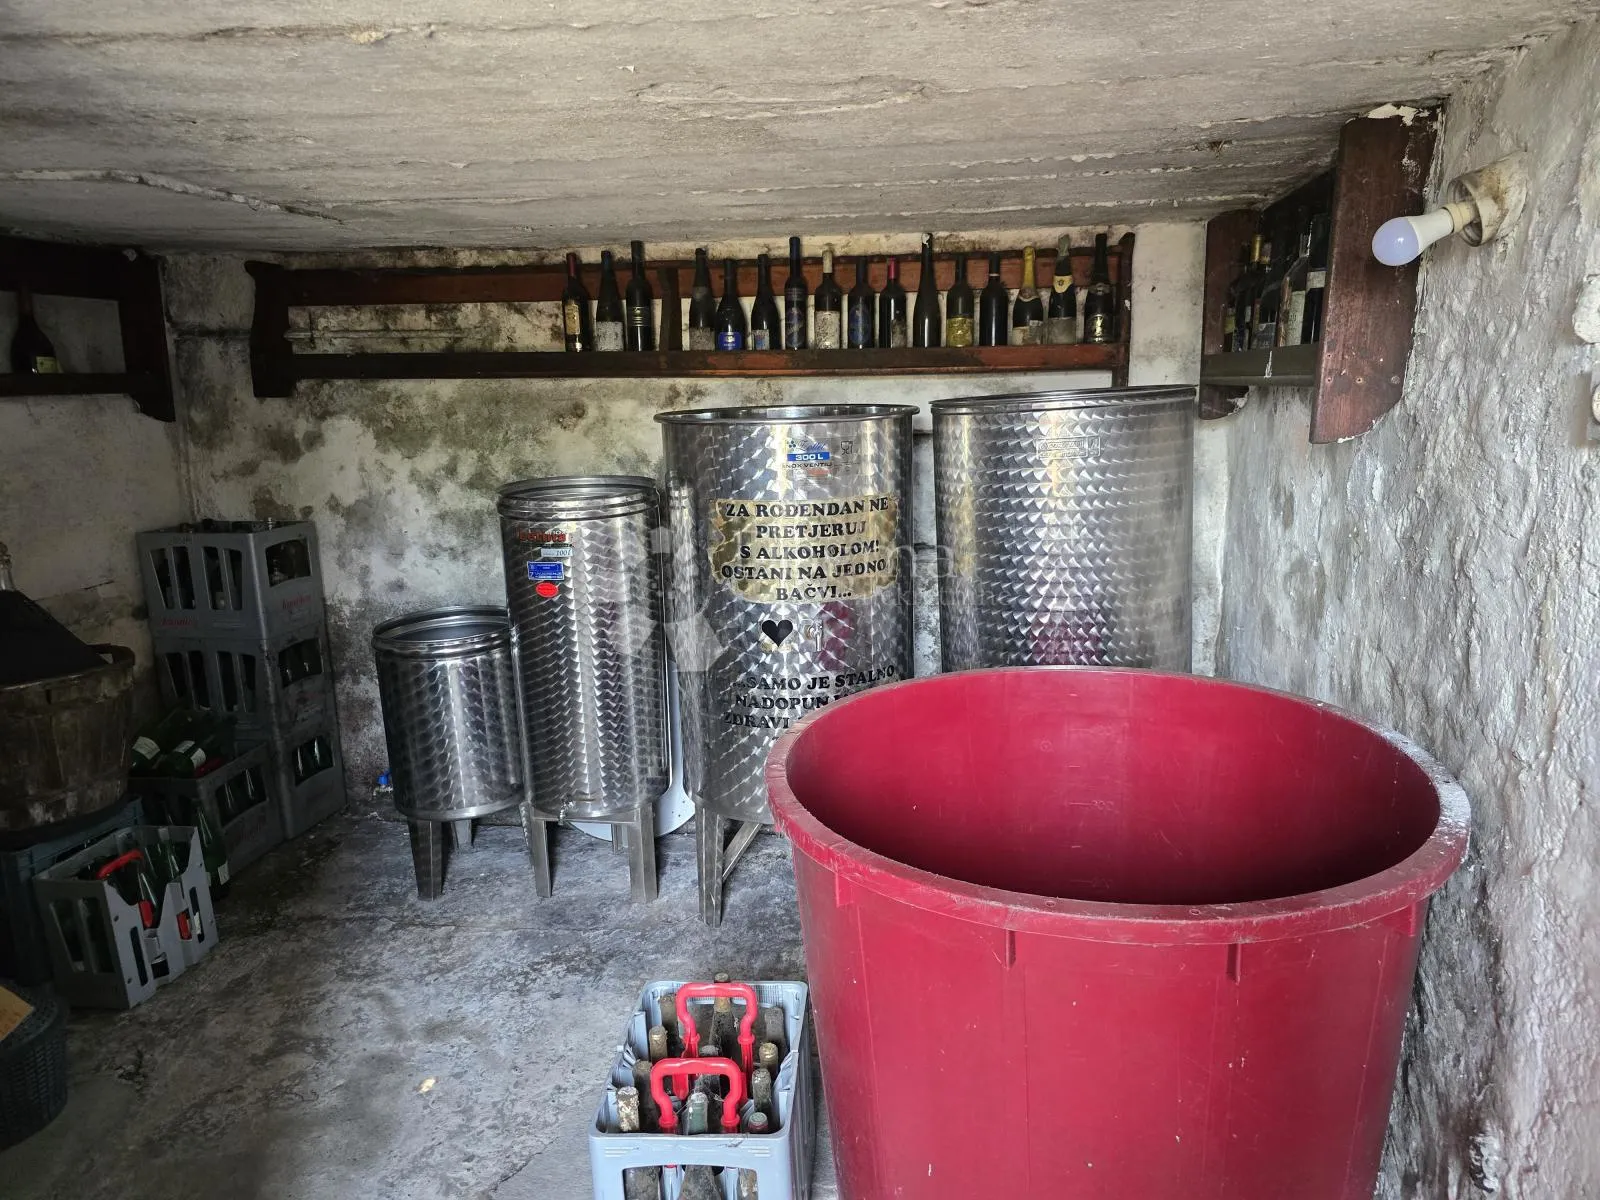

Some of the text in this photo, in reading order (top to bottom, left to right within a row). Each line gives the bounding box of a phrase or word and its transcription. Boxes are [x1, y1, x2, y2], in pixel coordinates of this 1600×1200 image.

[726, 497, 889, 517] ZA ROĐENDAN NE
[756, 520, 867, 538] PRETJERUJ
[740, 540, 880, 560] S ALKOHOLOM!
[721, 565, 792, 580] OSTANI
[797, 566, 827, 580] NA
[776, 584, 852, 601] BAČVI...
[807, 676, 831, 690] JE
[834, 665, 895, 687] STALNO
[735, 693, 849, 710] NADOPUN
[723, 712, 790, 729] ZDRAVI
